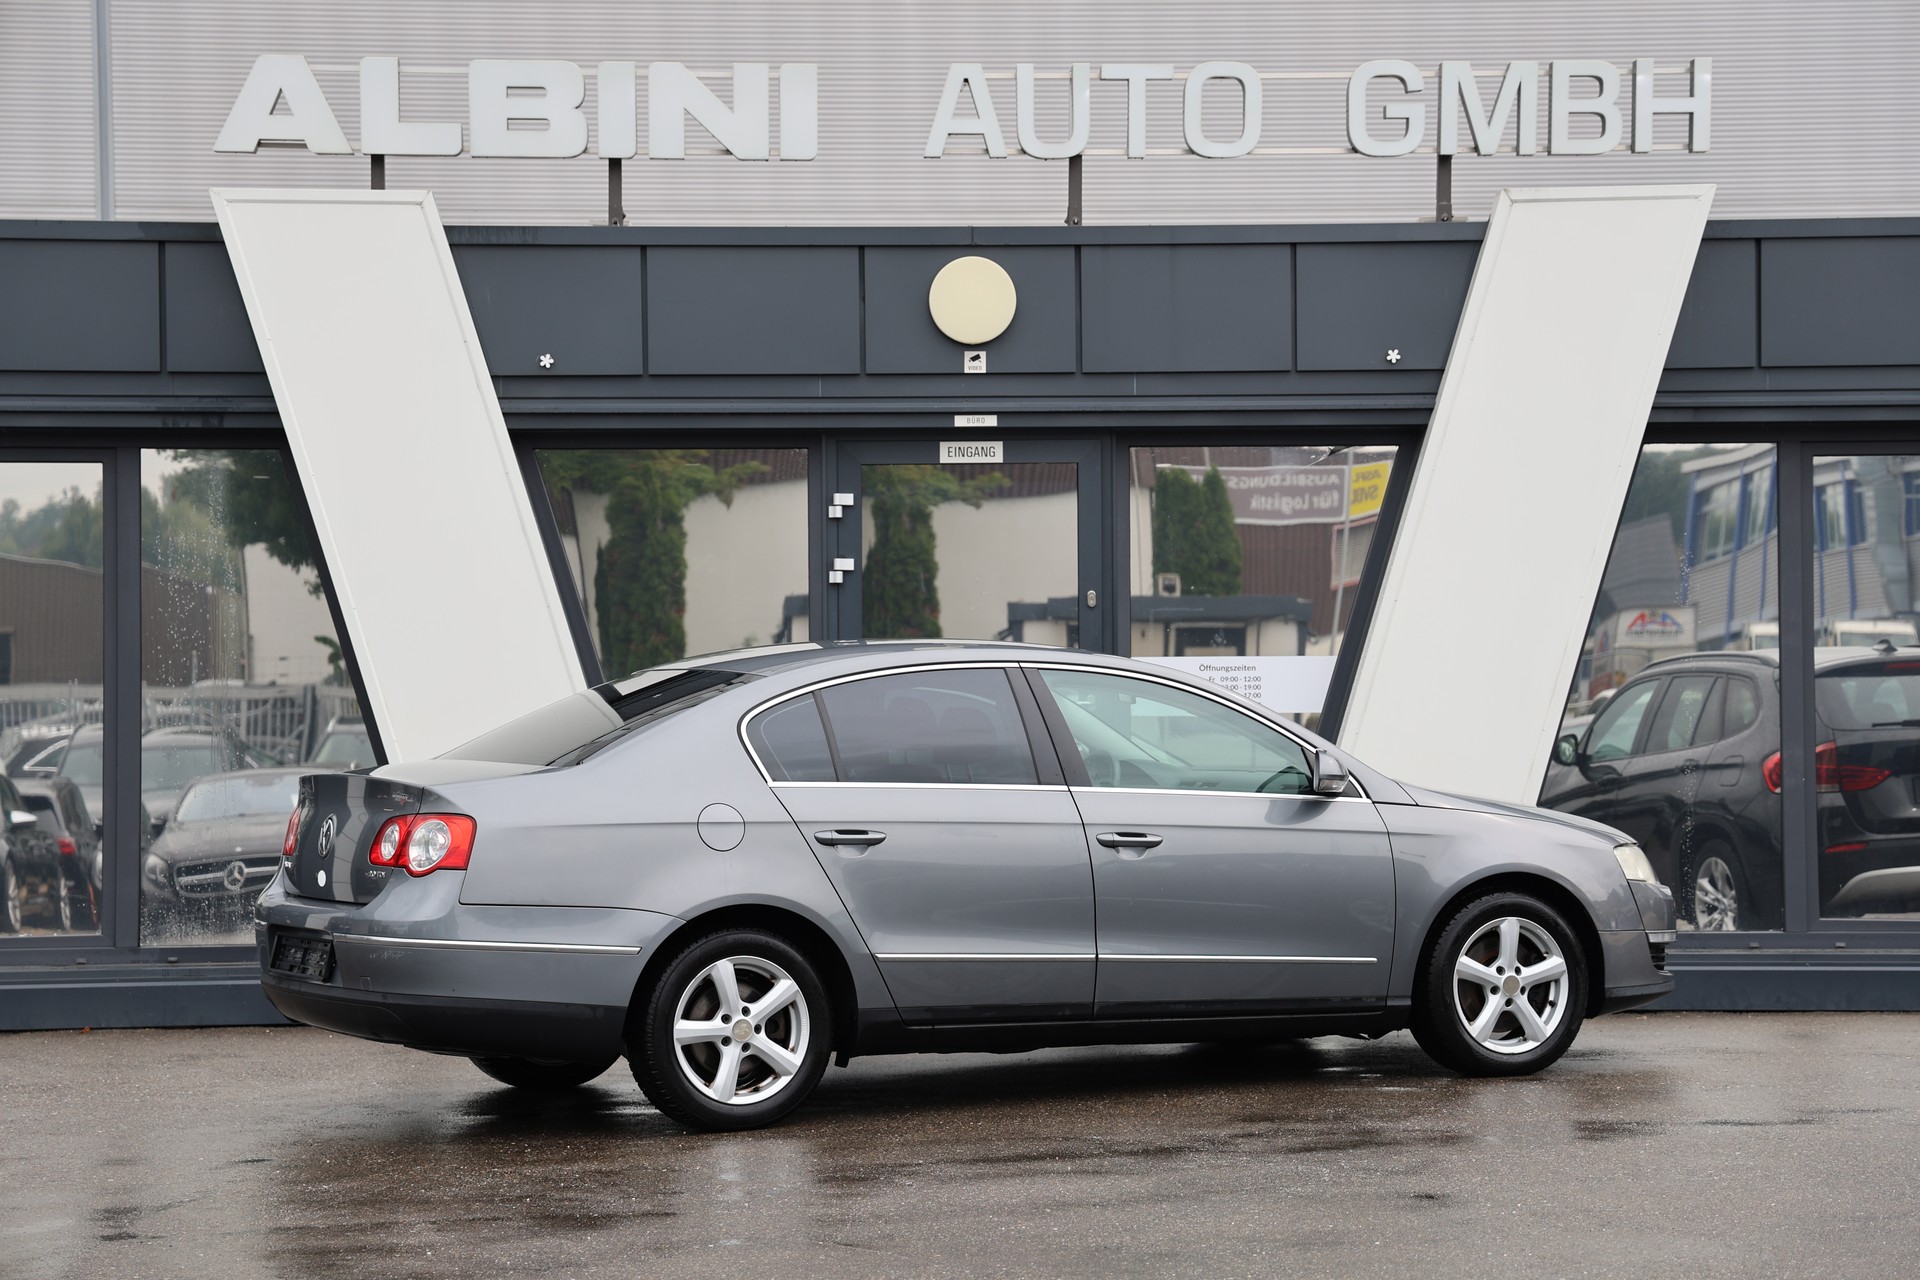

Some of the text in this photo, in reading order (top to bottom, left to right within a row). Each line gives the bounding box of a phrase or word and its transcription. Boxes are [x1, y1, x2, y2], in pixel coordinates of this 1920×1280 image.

[213, 54, 1713, 162] ALBINI AUTO GMBH
[966, 416, 986, 424] BÜRO
[947, 446, 996, 458] EINGANG
[1199, 663, 1257, 673] Öffnungszeiten
